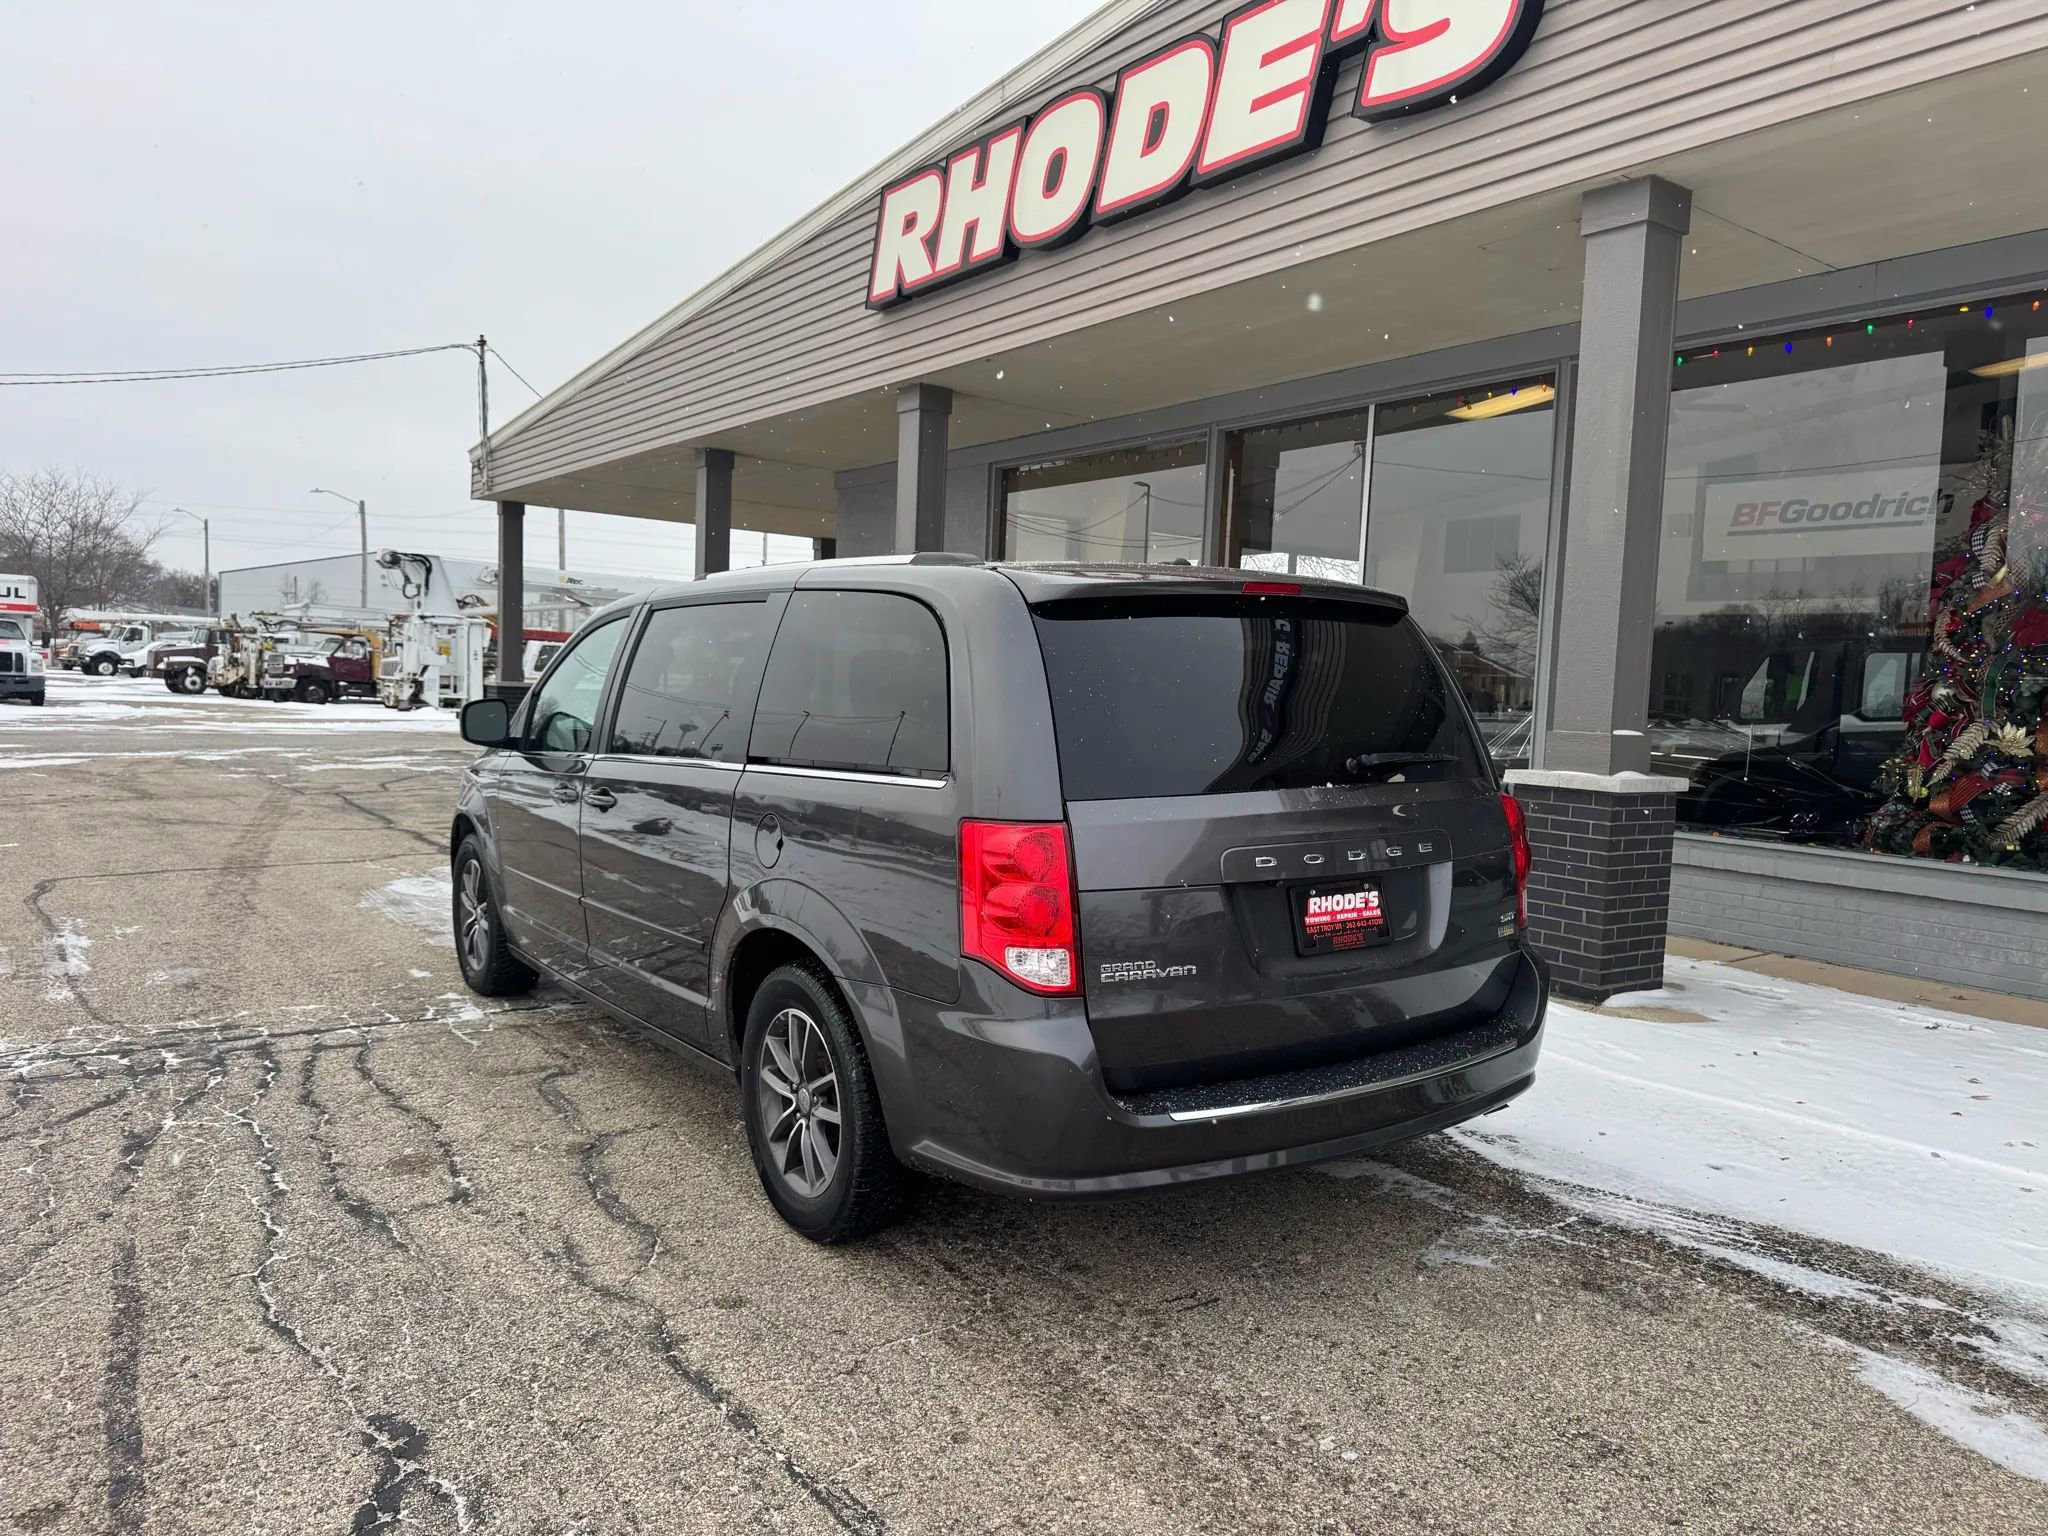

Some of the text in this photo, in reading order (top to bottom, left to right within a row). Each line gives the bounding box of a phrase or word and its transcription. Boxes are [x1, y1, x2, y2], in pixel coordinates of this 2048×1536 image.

[1729, 488, 1954, 526] BFGoodrich
[1255, 842, 1433, 867] DODGE
[1309, 890, 1379, 914] RHODE'S
[1305, 908, 1381, 924] TOWING REPAIR SALES
[1306, 926, 1320, 934] EAST
[1320, 923, 1334, 932] TROY
[1100, 960, 1156, 972] GRAND
[1100, 965, 1197, 983] CARAVAN
